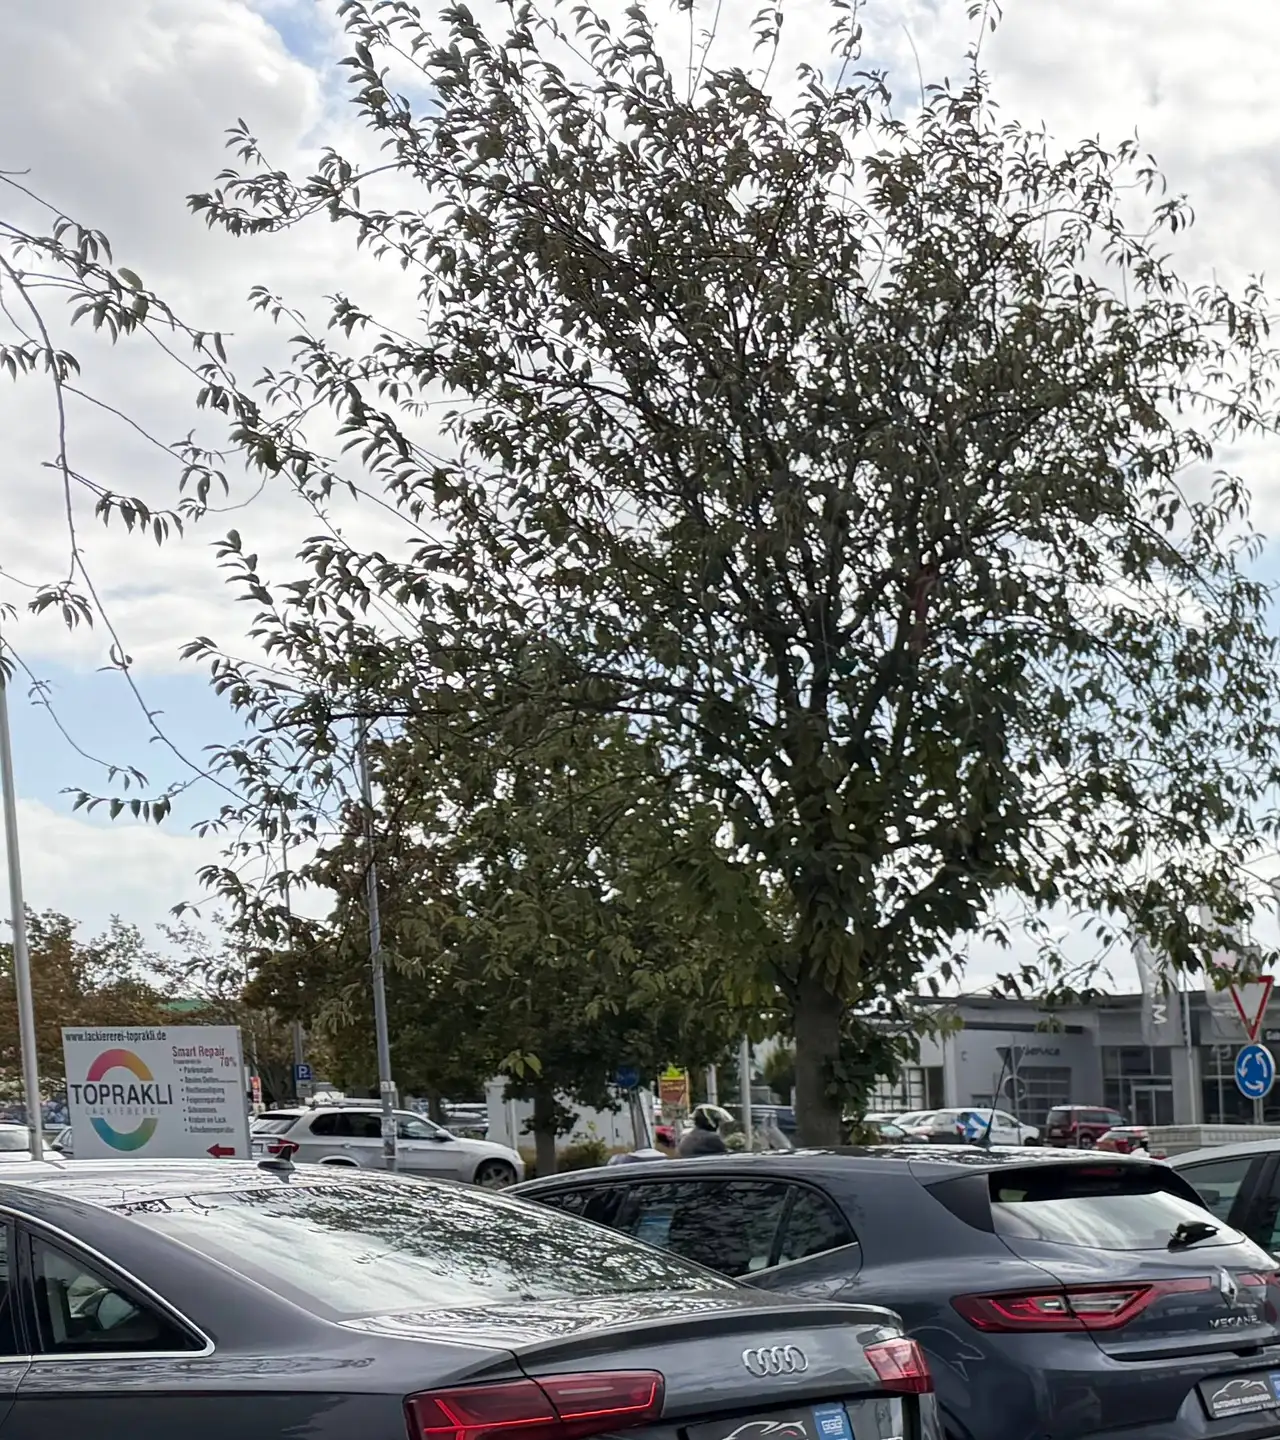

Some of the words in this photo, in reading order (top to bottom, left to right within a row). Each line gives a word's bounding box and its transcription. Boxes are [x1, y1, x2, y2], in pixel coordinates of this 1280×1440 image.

[172, 1046, 196, 1057] Smart
[198, 1045, 225, 1059] Repair
[70, 1084, 173, 1105] TOPRAKLI
